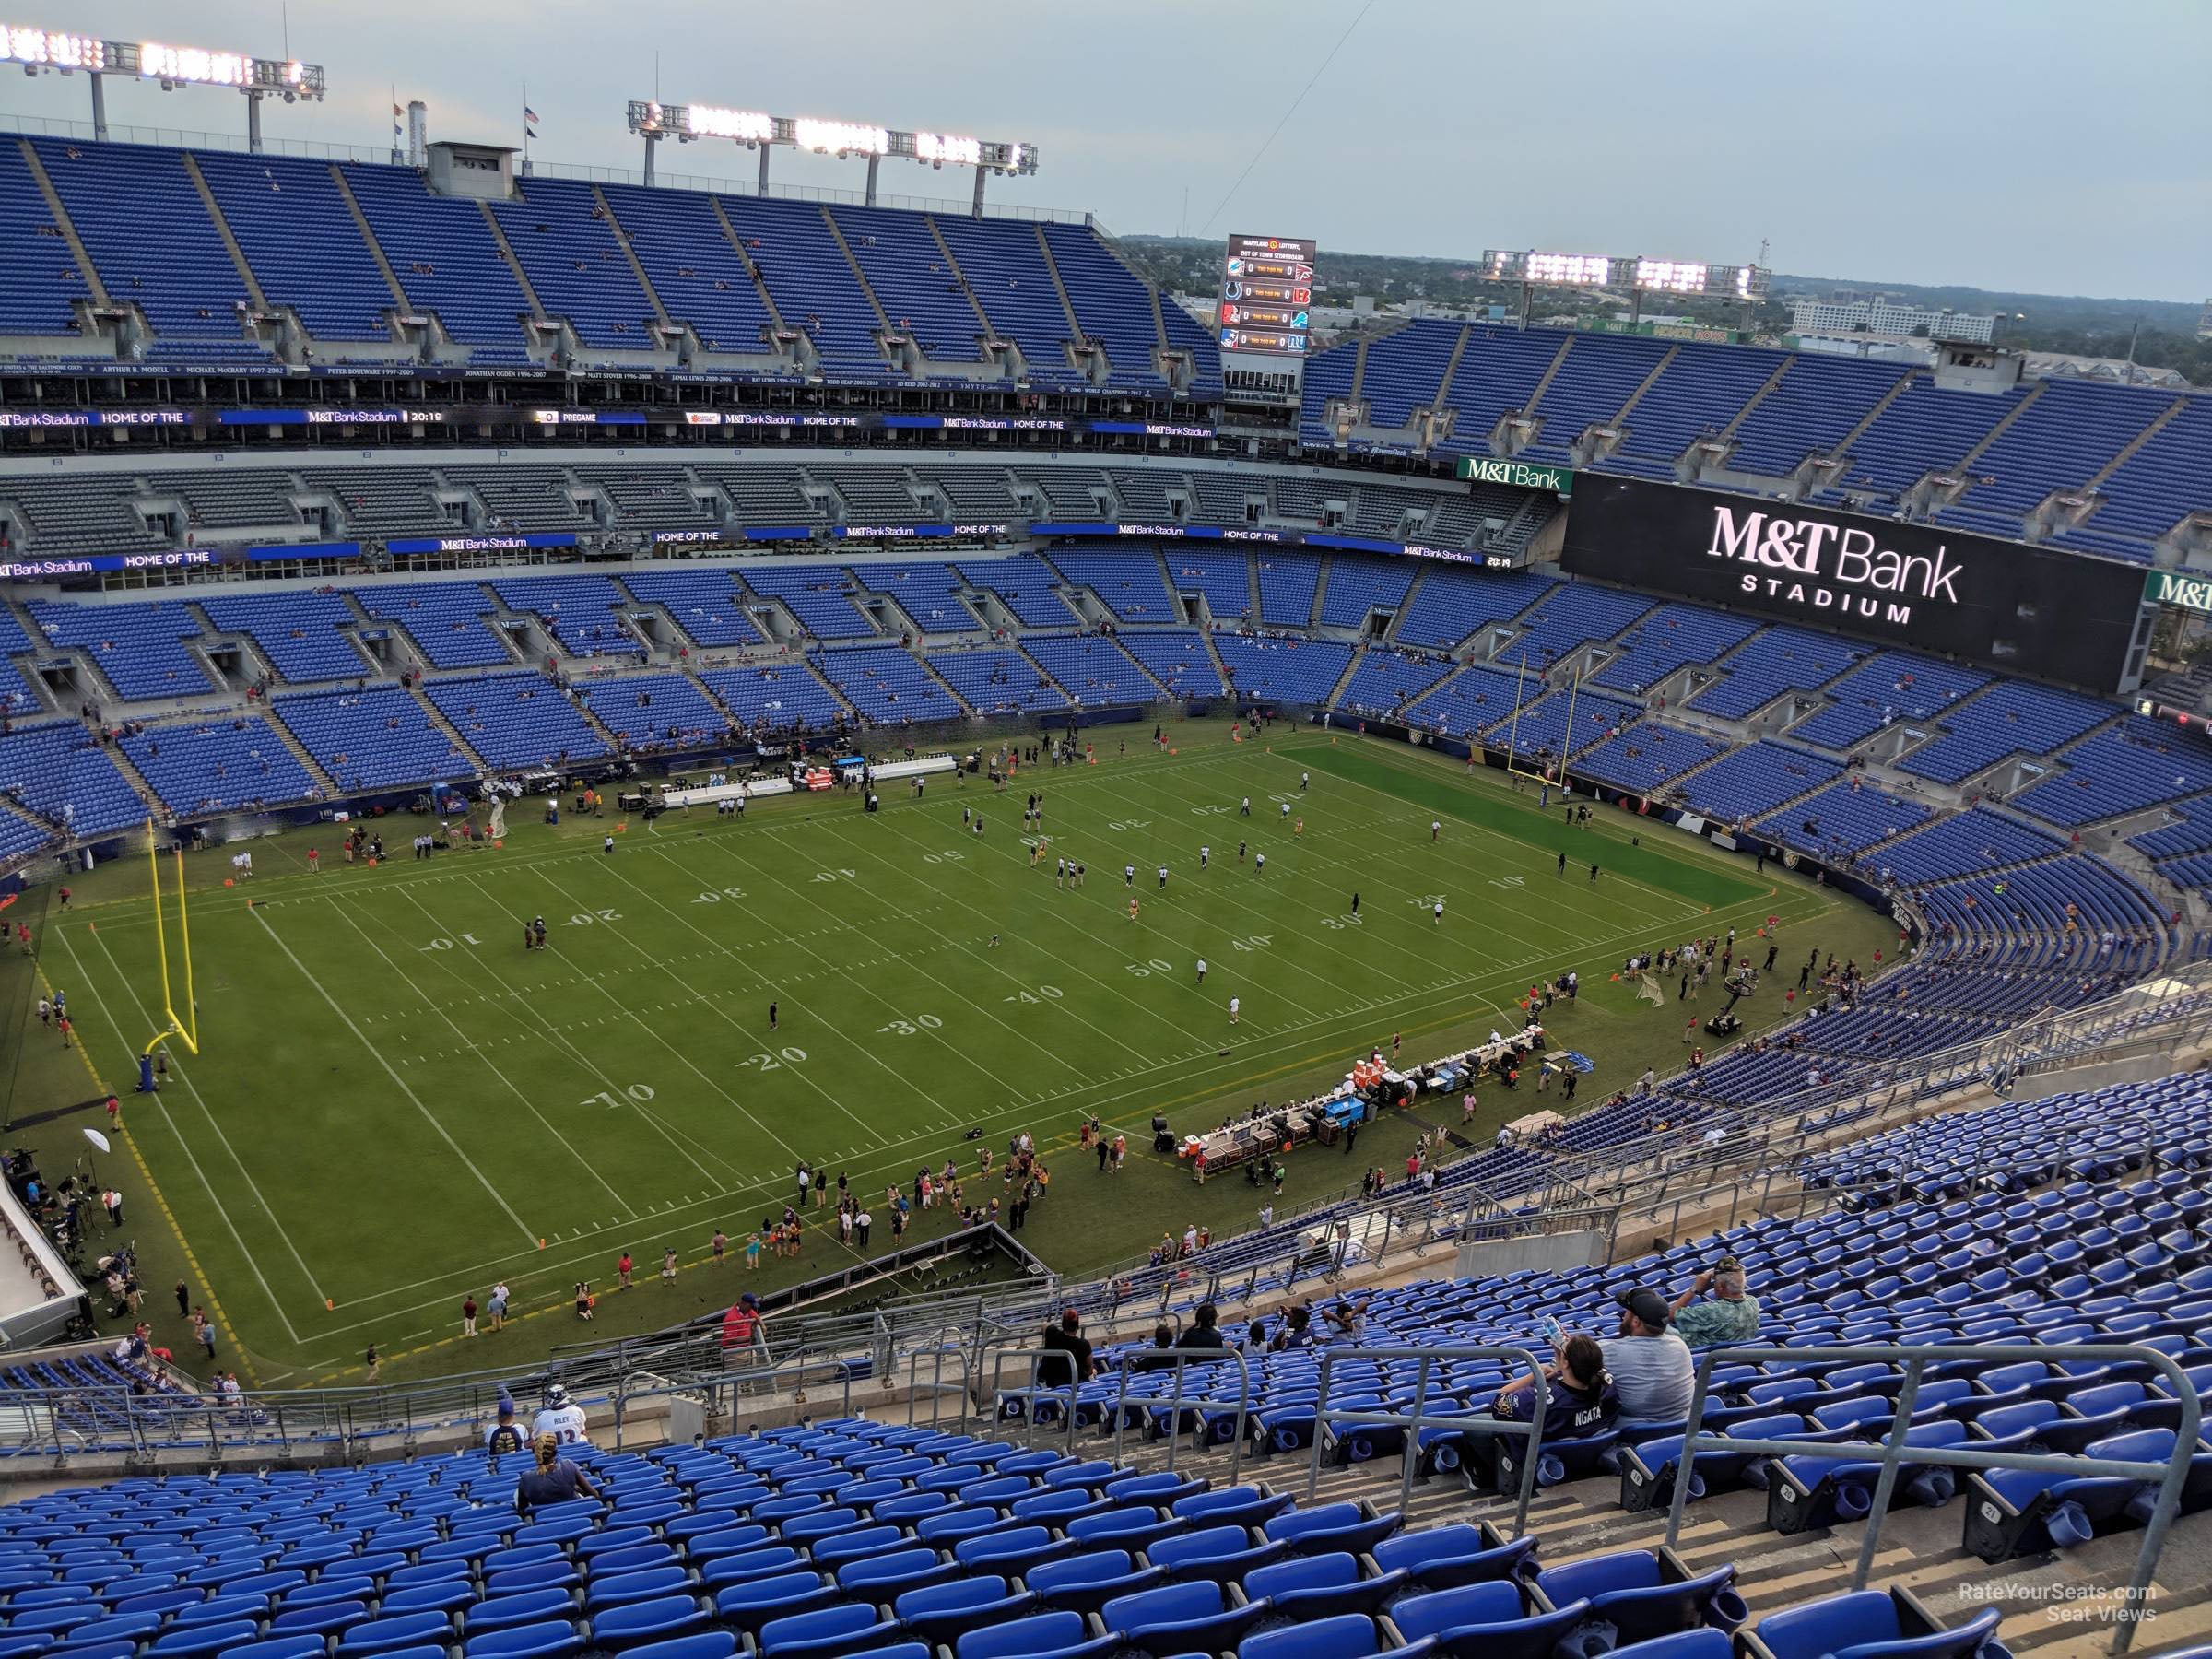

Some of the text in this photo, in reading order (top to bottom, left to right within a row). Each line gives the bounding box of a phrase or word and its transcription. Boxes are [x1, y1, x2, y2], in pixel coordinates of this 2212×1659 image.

[1248, 264, 1253, 273] 0
[1287, 266, 1292, 276] 0
[1246, 288, 1252, 297] 0
[1285, 290, 1290, 300] 0
[1243, 312, 1250, 320] 0
[1282, 314, 1288, 323] 0
[1241, 335, 1247, 344] 0
[1695, 330, 1728, 341] ROWS
[1279, 338, 1286, 347] 0
[14, 415, 41, 426] Bank
[43, 414, 88, 425] Stadium
[103, 413, 184, 424] HOME OF THE
[309, 412, 397, 422] M&T Bank Stadium
[563, 413, 596, 422] PREGAME
[725, 415, 745, 424] M&T
[746, 415, 765, 424] Bank
[765, 416, 796, 424] Stadium
[804, 417, 857, 426] HOME OF THE
[944, 418, 1006, 429] M&T Bank Stadium
[1049, 421, 1064, 429] THE
[1147, 425, 1211, 437] M&T Bank Stadium
[1303, 441, 1330, 450] RAVENS
[1371, 446, 1406, 457] #RavensFlock
[1467, 459, 1561, 490] M&T Bank
[847, 527, 914, 537] M&T Bank Stadium
[954, 525, 977, 534] HOME
[1119, 525, 1183, 536] M&T Bank Stadium
[657, 533, 684, 542] HOME
[686, 533, 699, 541] OF
[1224, 530, 1279, 541] HOME OF THE
[441, 538, 527, 551] M&T Bank Stadium
[125, 552, 209, 567] HOME OF THE
[1404, 546, 1473, 562] M&T Bank Stadium
[1706, 506, 1965, 604] M&T Bank
[14, 564, 43, 576] Bank
[44, 560, 92, 573] Stadium
[2157, 574, 2212, 610] M&T
[1740, 573, 1911, 625] STADIUM
[1231, 936, 1272, 951] 40
[1124, 959, 1172, 977] 50
[1019, 985, 1064, 1003] 40
[888, 1014, 943, 1036] 30
[748, 1047, 807, 1071] 20
[594, 1084, 654, 1109] 10
[1575, 1406, 1602, 1427] NGATA
[1784, 1488, 1792, 1499] 20
[1985, 1506, 1996, 1519] 21
